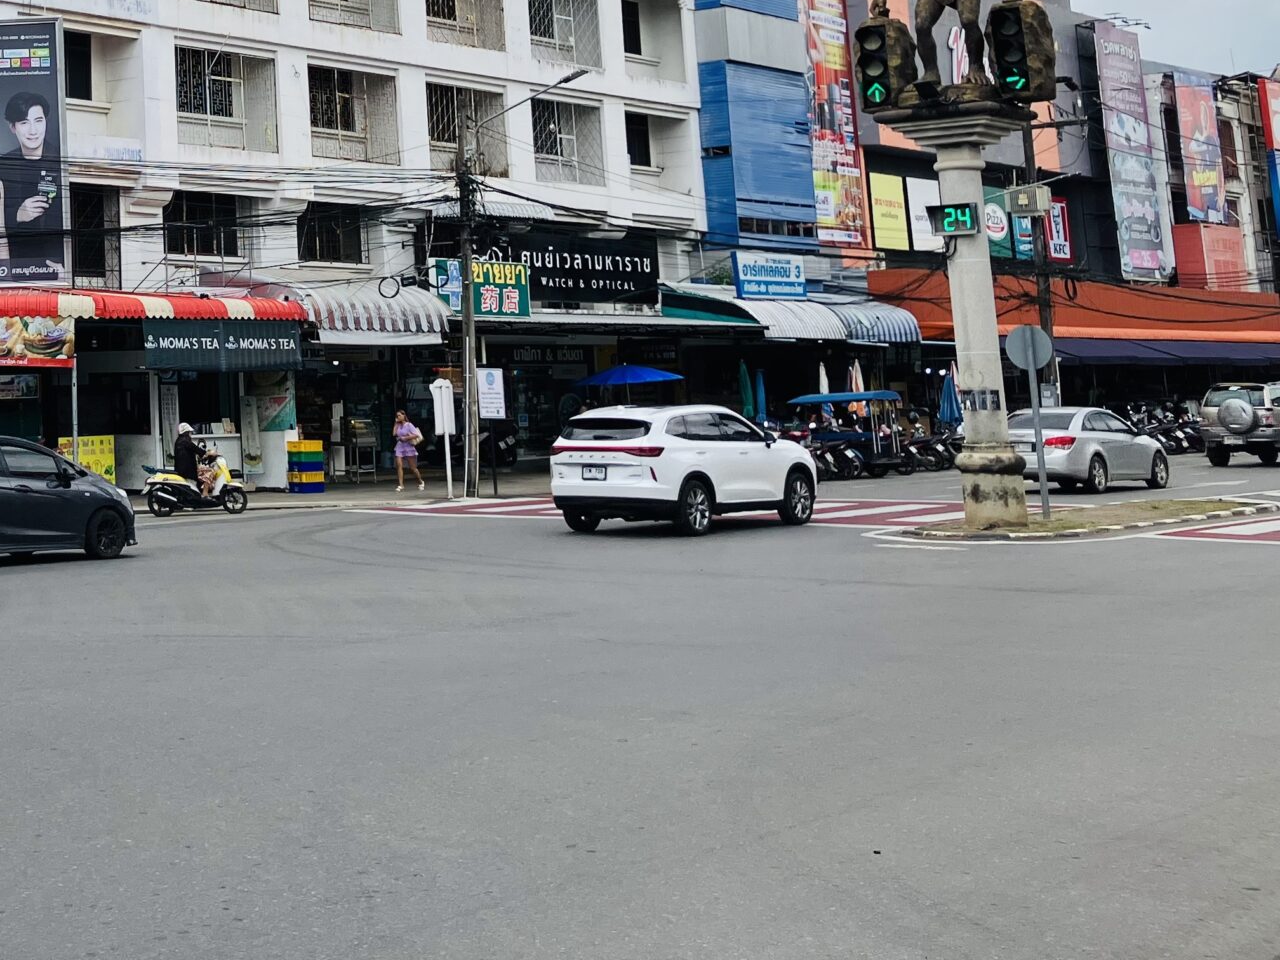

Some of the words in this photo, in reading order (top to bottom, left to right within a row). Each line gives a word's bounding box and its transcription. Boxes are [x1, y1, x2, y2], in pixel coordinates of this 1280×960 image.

[943, 207, 971, 232] 24
[1053, 242, 1068, 256] KFC
[472, 262, 527, 285] ขายยา
[795, 265, 801, 279] 3
[540, 276, 574, 288] WATCH
[579, 278, 585, 289] &
[591, 279, 636, 291] OPTICAL
[480, 285, 520, 314] 药店
[159, 337, 199, 350] MOMA'S
[201, 337, 220, 350] TEA
[239, 338, 277, 350] MOMA'S
[279, 338, 297, 350] TEA
